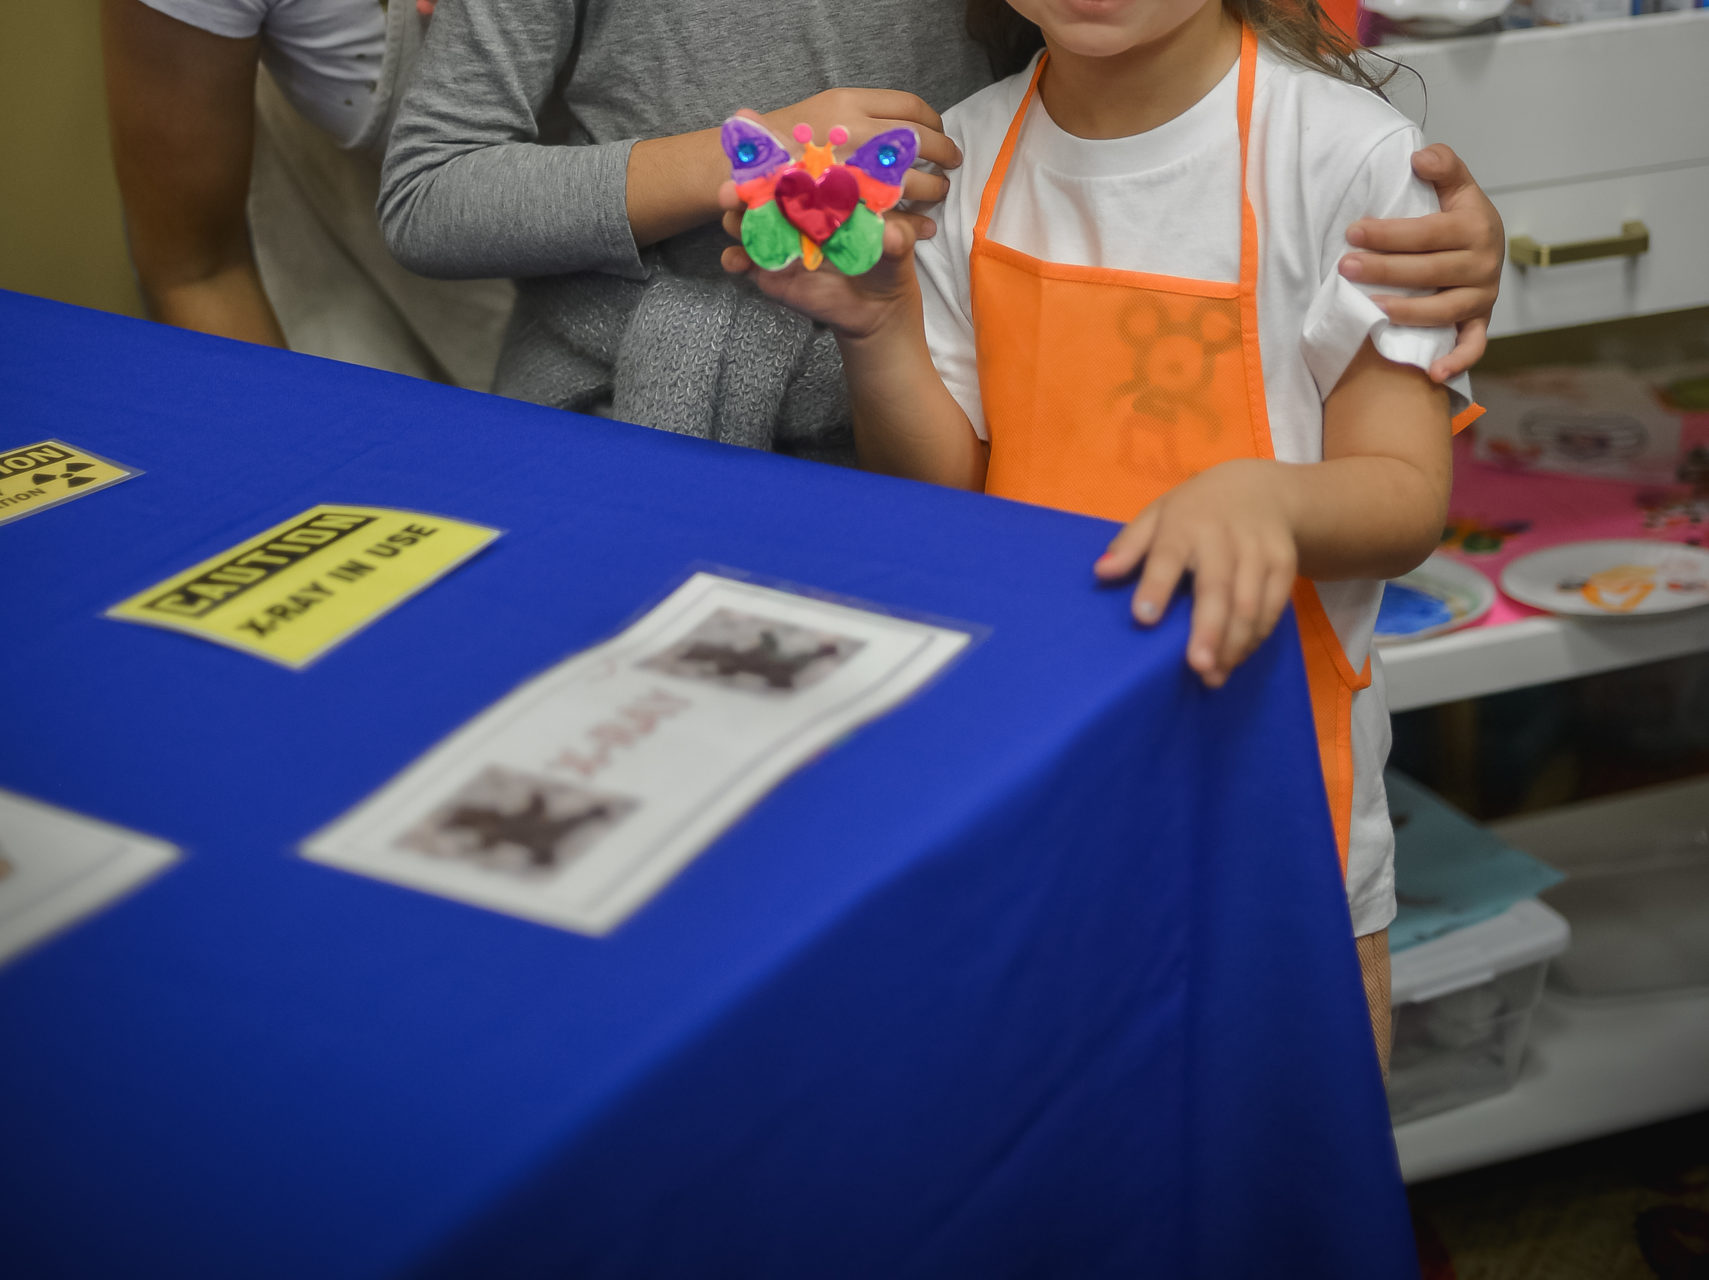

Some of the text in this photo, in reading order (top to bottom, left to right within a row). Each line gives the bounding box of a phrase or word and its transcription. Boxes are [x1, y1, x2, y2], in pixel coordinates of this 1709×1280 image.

[150, 514, 366, 616] CAUTION
[235, 523, 439, 638] X-RAY IN USE
